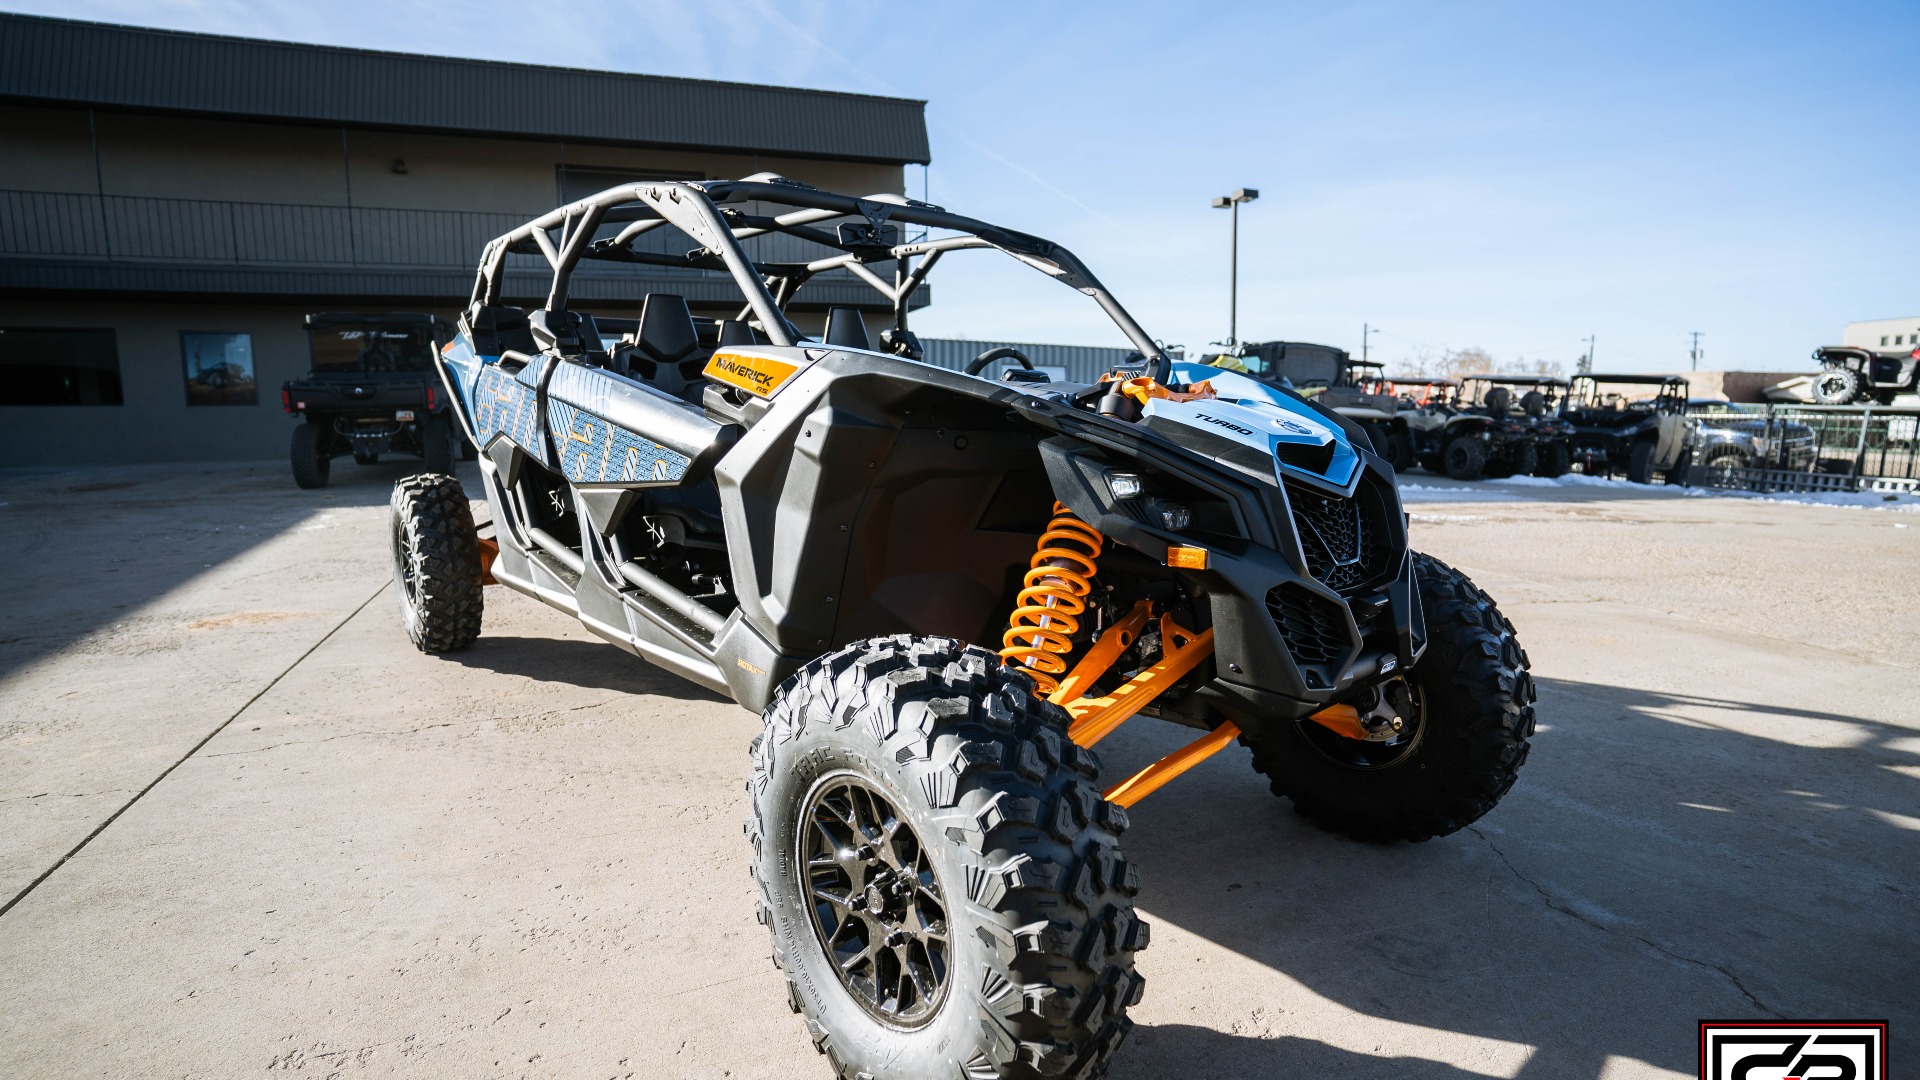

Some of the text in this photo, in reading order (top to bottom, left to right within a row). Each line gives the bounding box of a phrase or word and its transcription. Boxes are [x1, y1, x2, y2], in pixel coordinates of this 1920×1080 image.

[715, 357, 775, 387] MAVERICK
[1194, 413, 1254, 436] TURBO
[737, 656, 758, 675] ROTAX
[788, 745, 836, 783] TRAC
